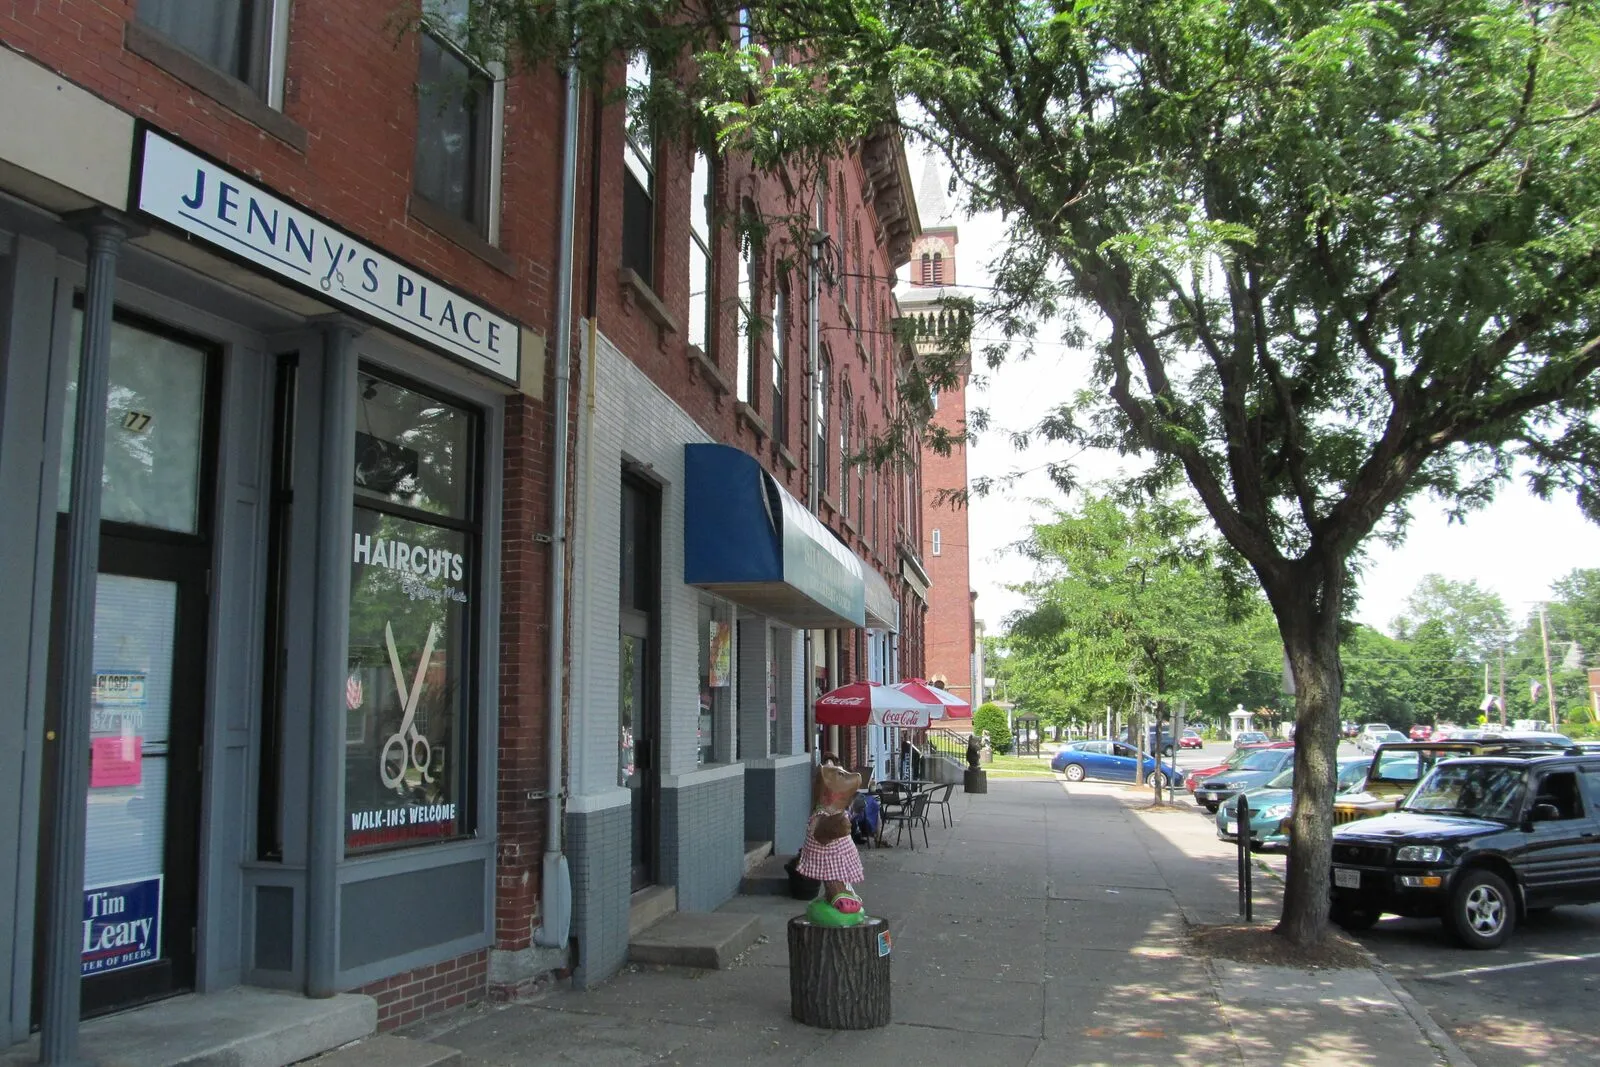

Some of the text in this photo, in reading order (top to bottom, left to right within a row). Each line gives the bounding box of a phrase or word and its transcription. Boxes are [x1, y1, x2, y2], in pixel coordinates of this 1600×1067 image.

[180, 168, 501, 355] JENNY'S PLACE
[126, 411, 152, 430] 77
[353, 532, 464, 582] HAIRCUTS
[882, 709, 920, 726] Coca-Cola
[351, 803, 456, 831] WALK-INS WELCOME
[88, 891, 125, 918] Tim
[81, 917, 153, 954] Leary
[106, 957, 119, 967] OF
[122, 948, 152, 963] DEEDS
